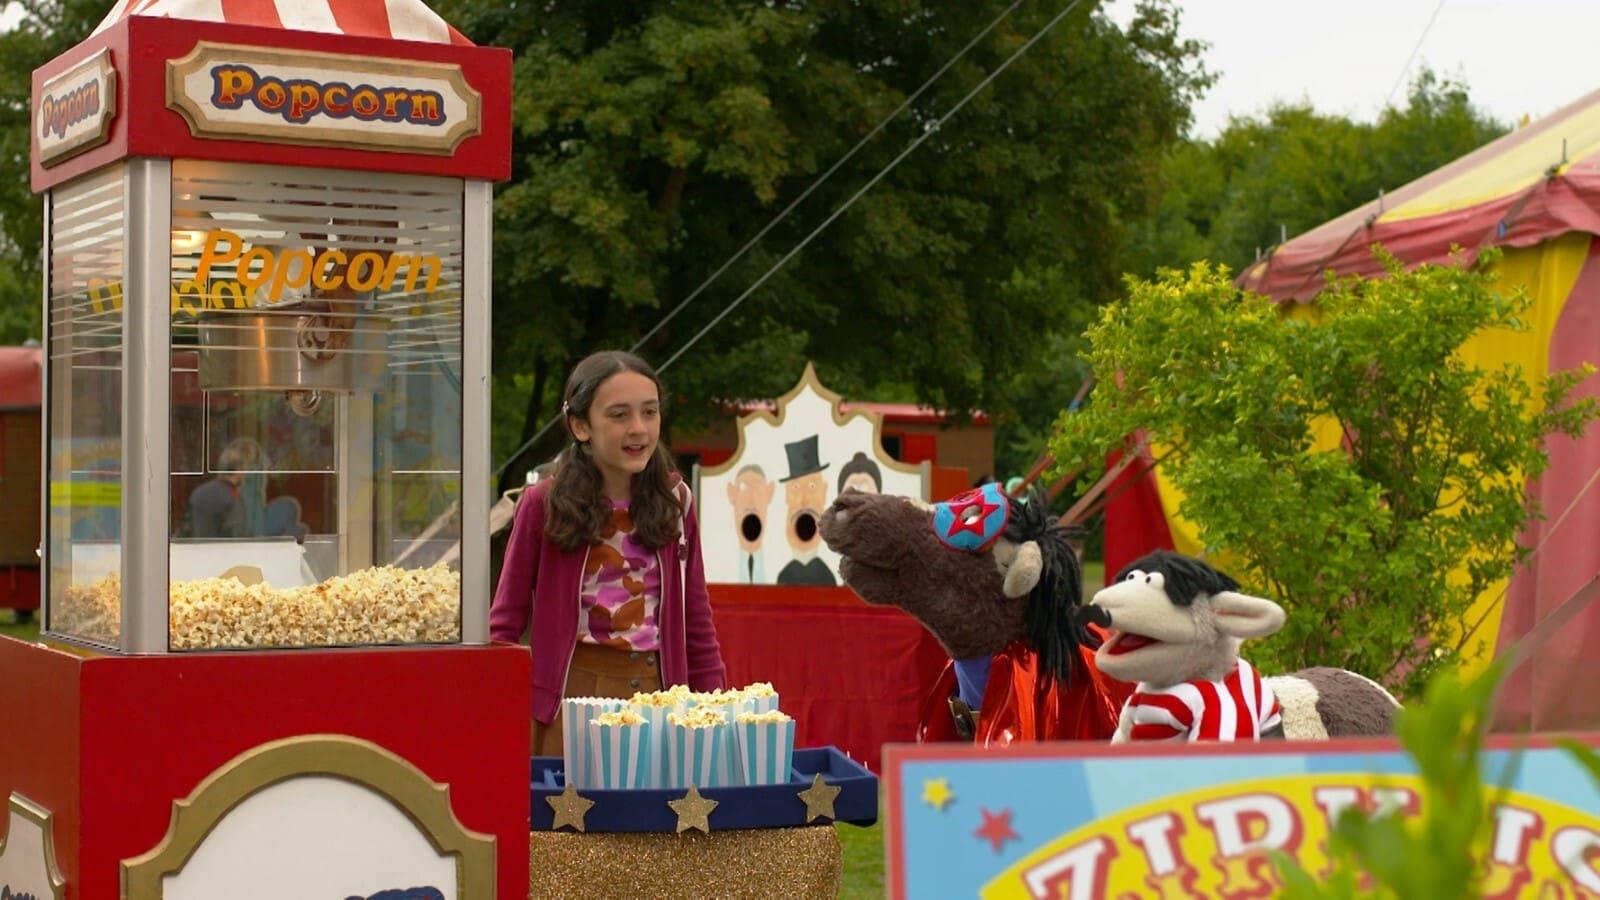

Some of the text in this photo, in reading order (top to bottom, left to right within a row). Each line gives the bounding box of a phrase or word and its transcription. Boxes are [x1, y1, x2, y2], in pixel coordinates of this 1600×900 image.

[43, 78, 99, 139] Popcorn
[212, 66, 446, 125] Popcorn
[196, 229, 443, 302] Popcorn
